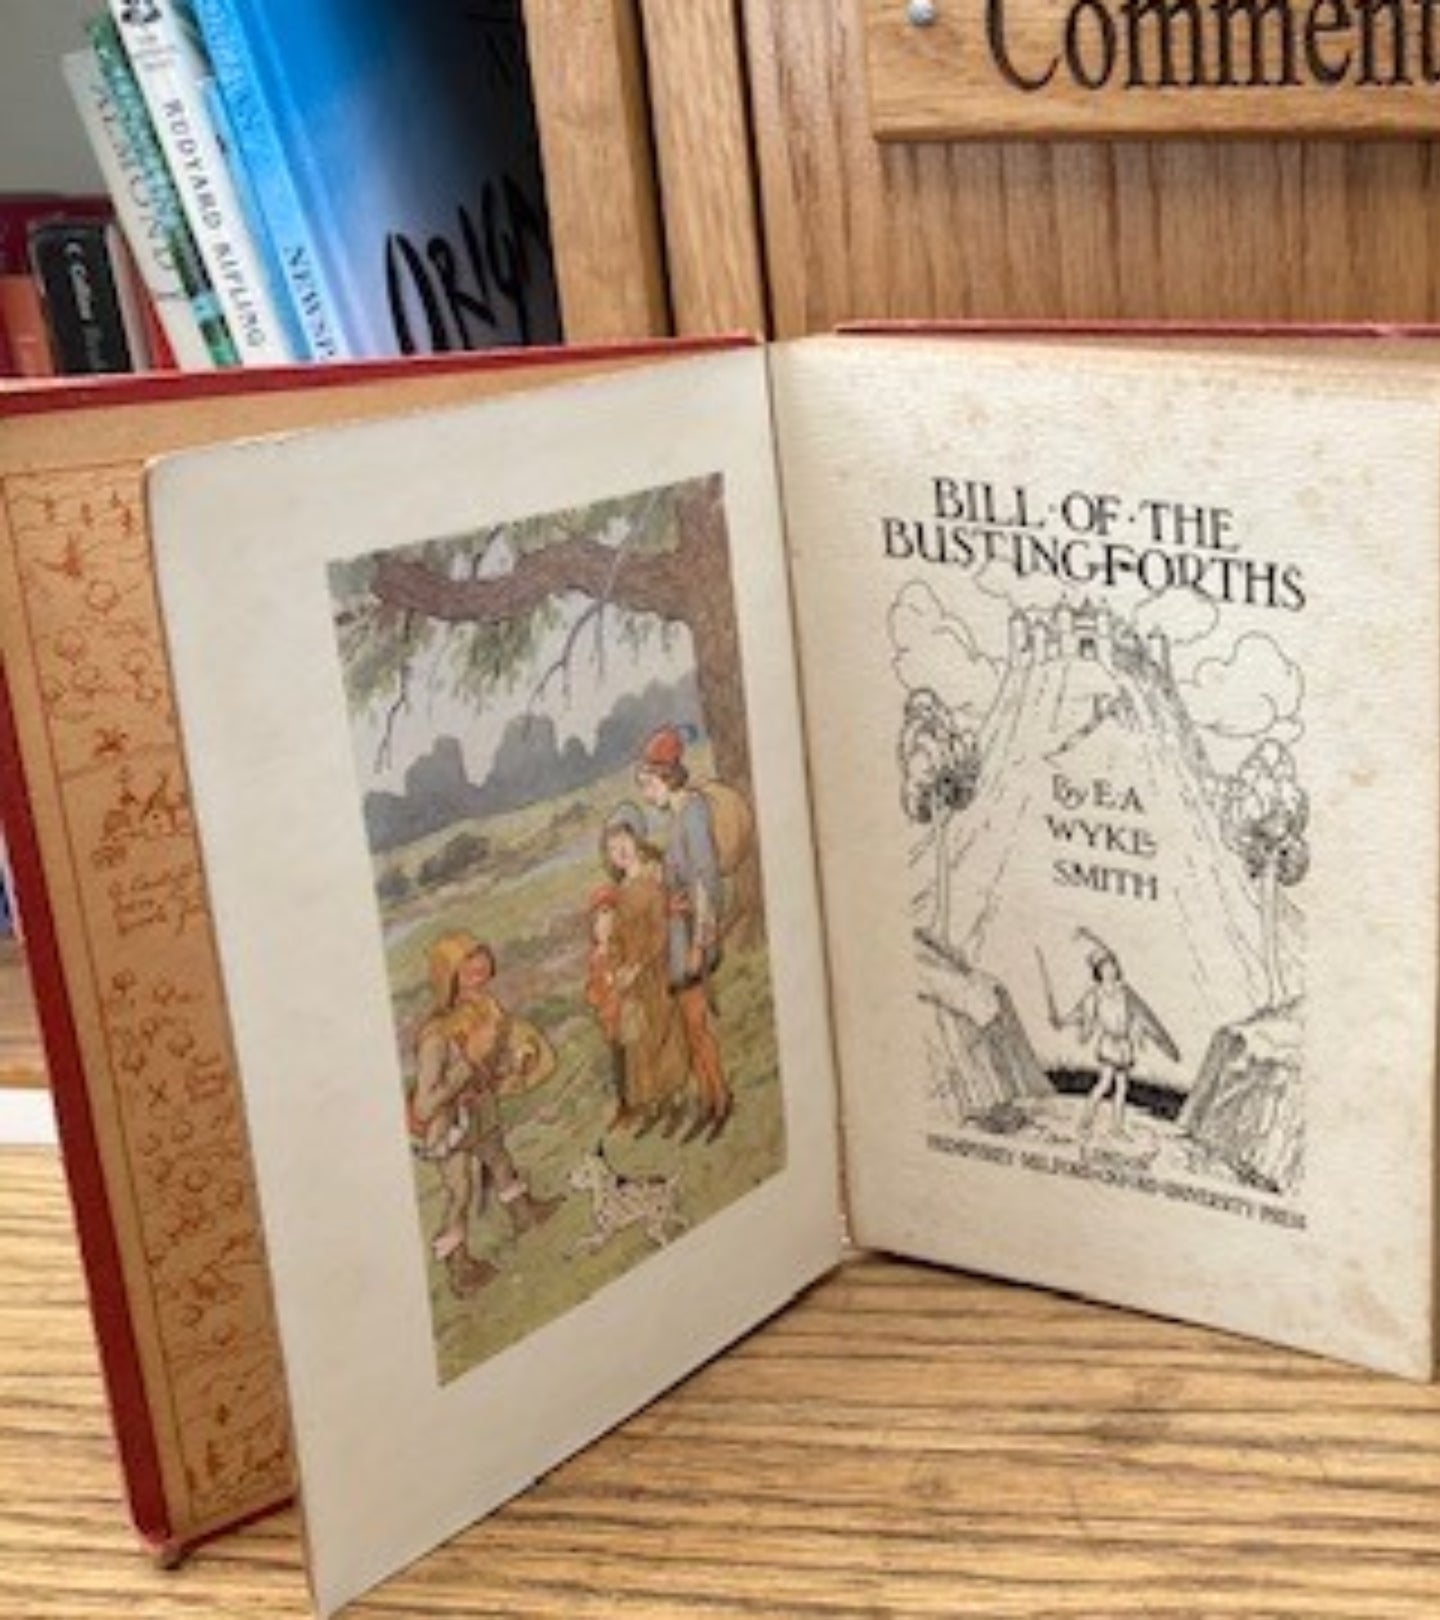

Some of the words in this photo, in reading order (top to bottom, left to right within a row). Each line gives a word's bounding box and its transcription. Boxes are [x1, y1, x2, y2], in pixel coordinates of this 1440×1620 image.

[932, 476, 1046, 529] BILL
[1061, 490, 1121, 536] OF
[1139, 499, 1241, 553] THE
[881, 515, 1308, 613] BUSTINGFORTHS
[1052, 858, 1159, 902] SMITH
